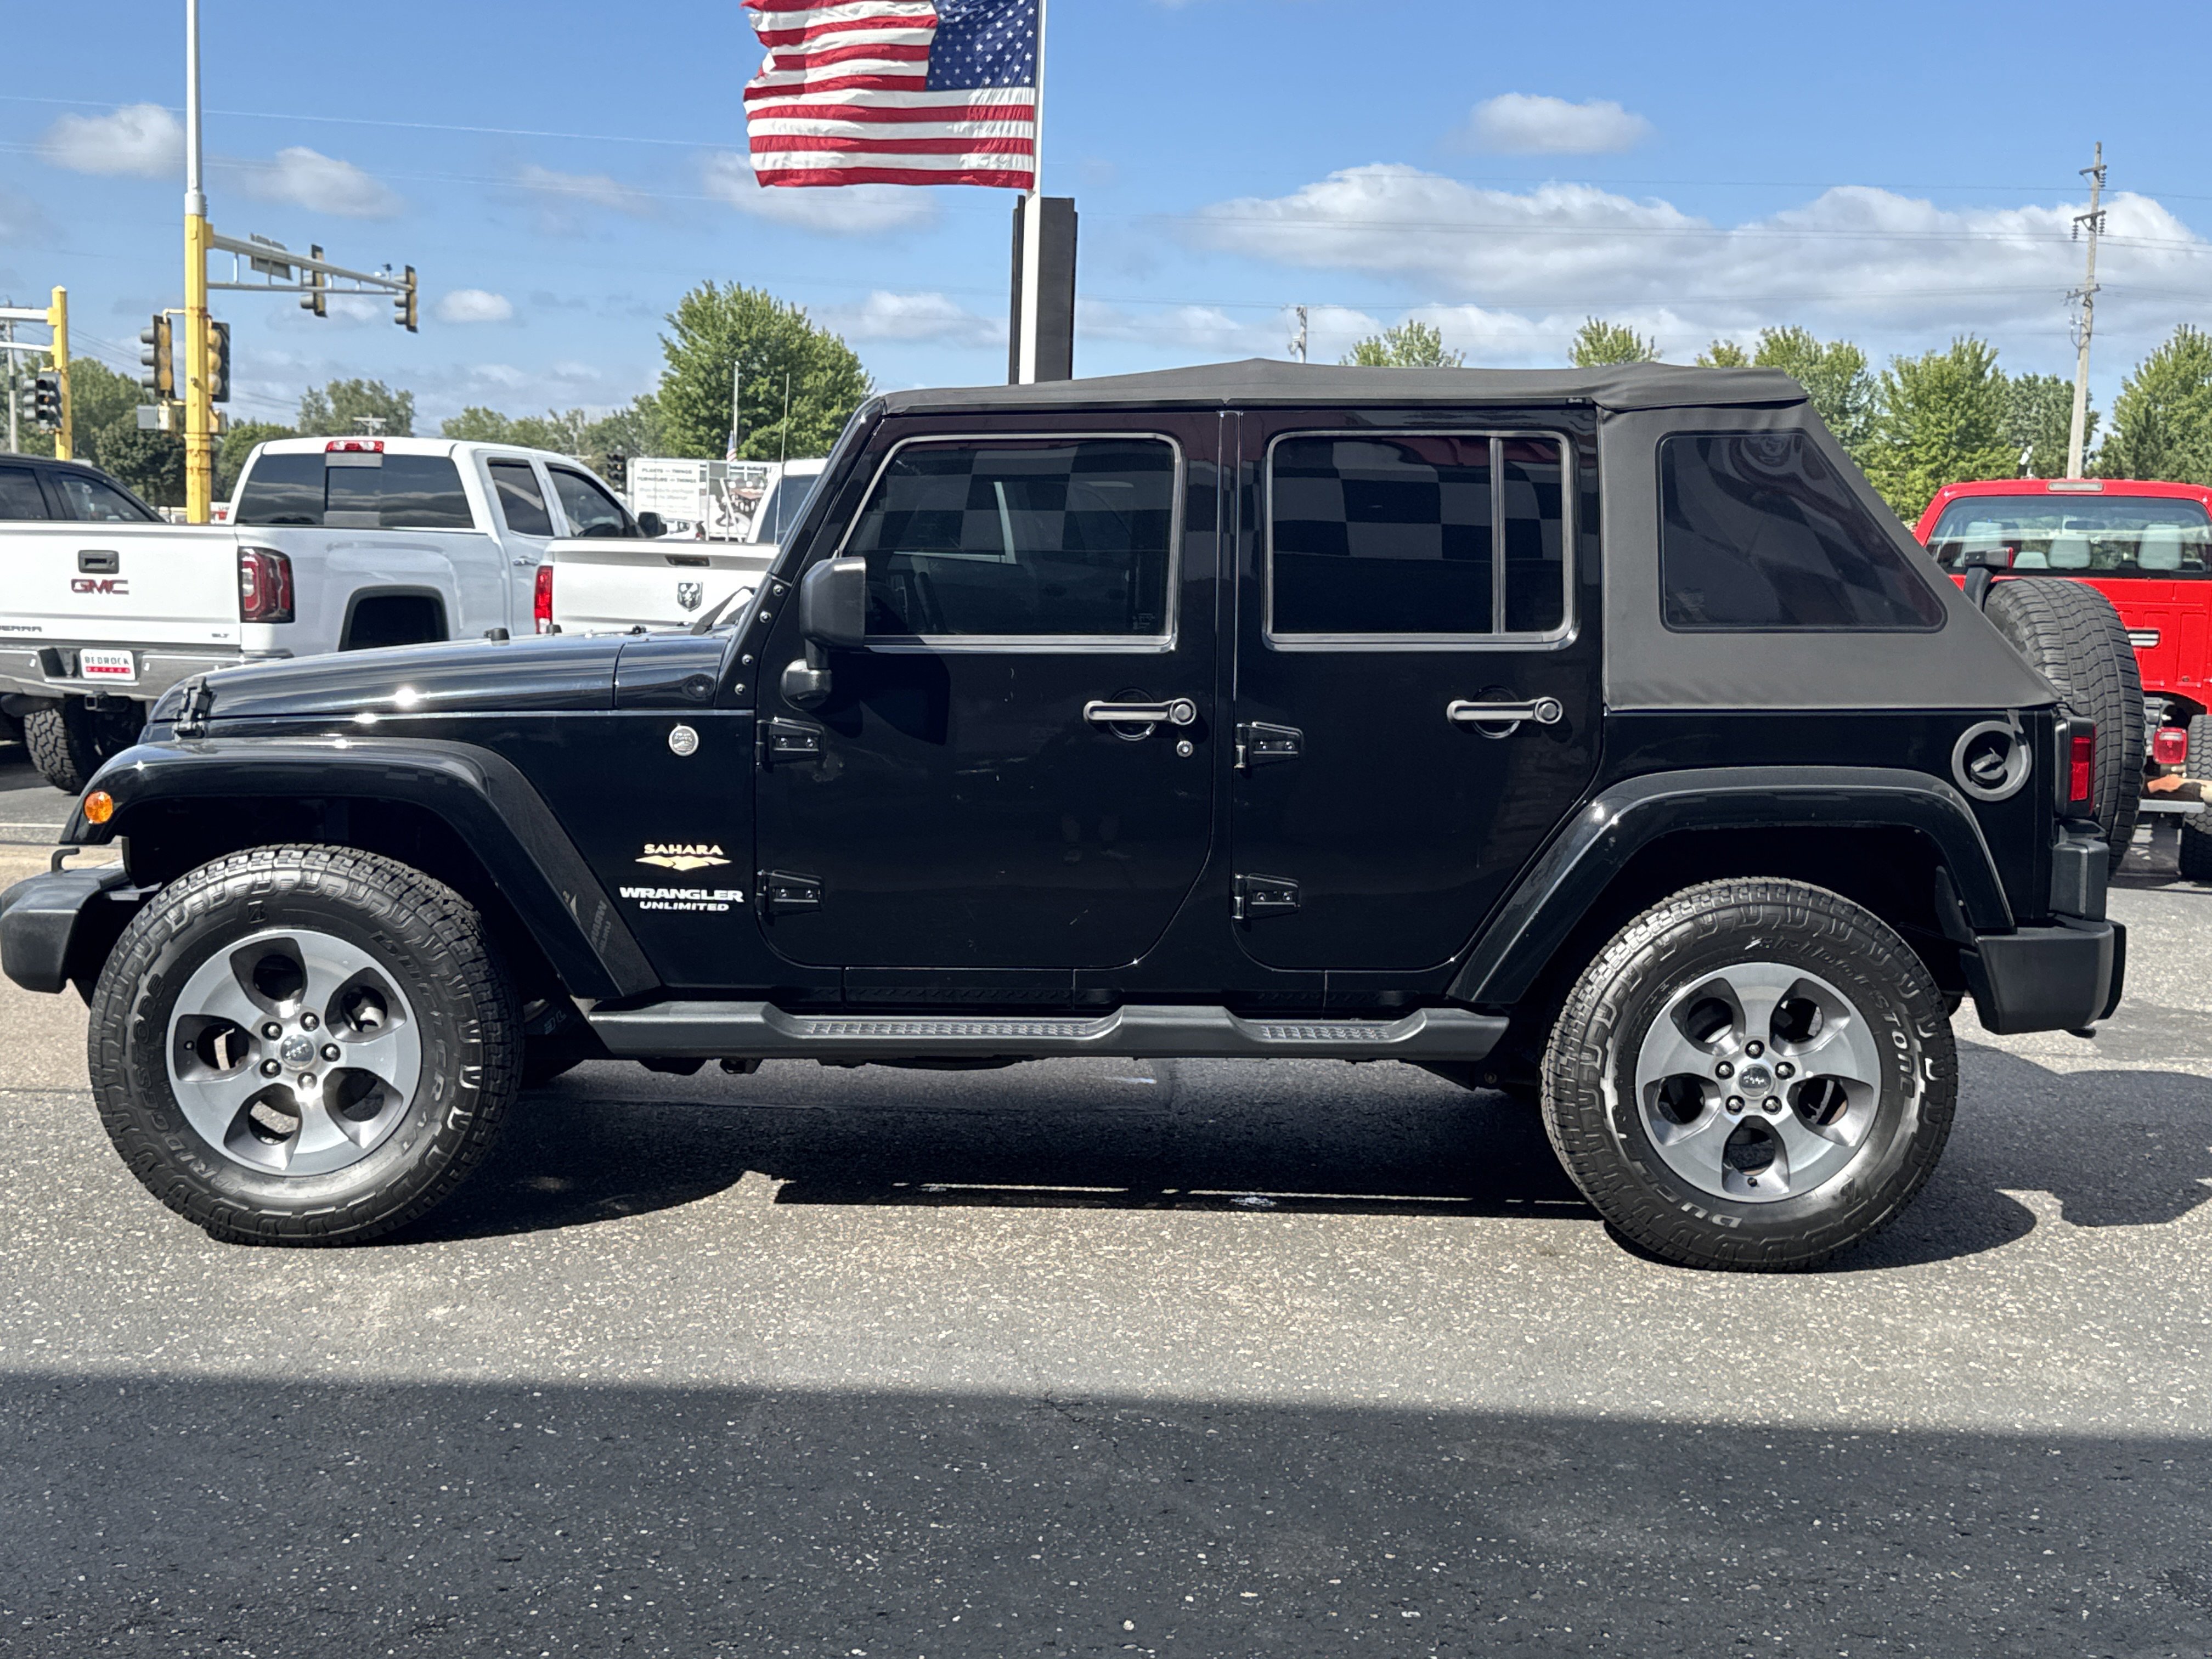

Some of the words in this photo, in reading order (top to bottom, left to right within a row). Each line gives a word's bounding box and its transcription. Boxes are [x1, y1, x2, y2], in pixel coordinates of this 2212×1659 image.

[71, 579, 129, 595] GMC
[644, 844, 724, 855] SAHARA
[619, 887, 744, 902] WRANGLER
[639, 901, 729, 911] UNLIMITED
[1745, 934, 1915, 1098] BRIDGESTONE
[132, 973, 242, 1195] BRIDGESTONE
